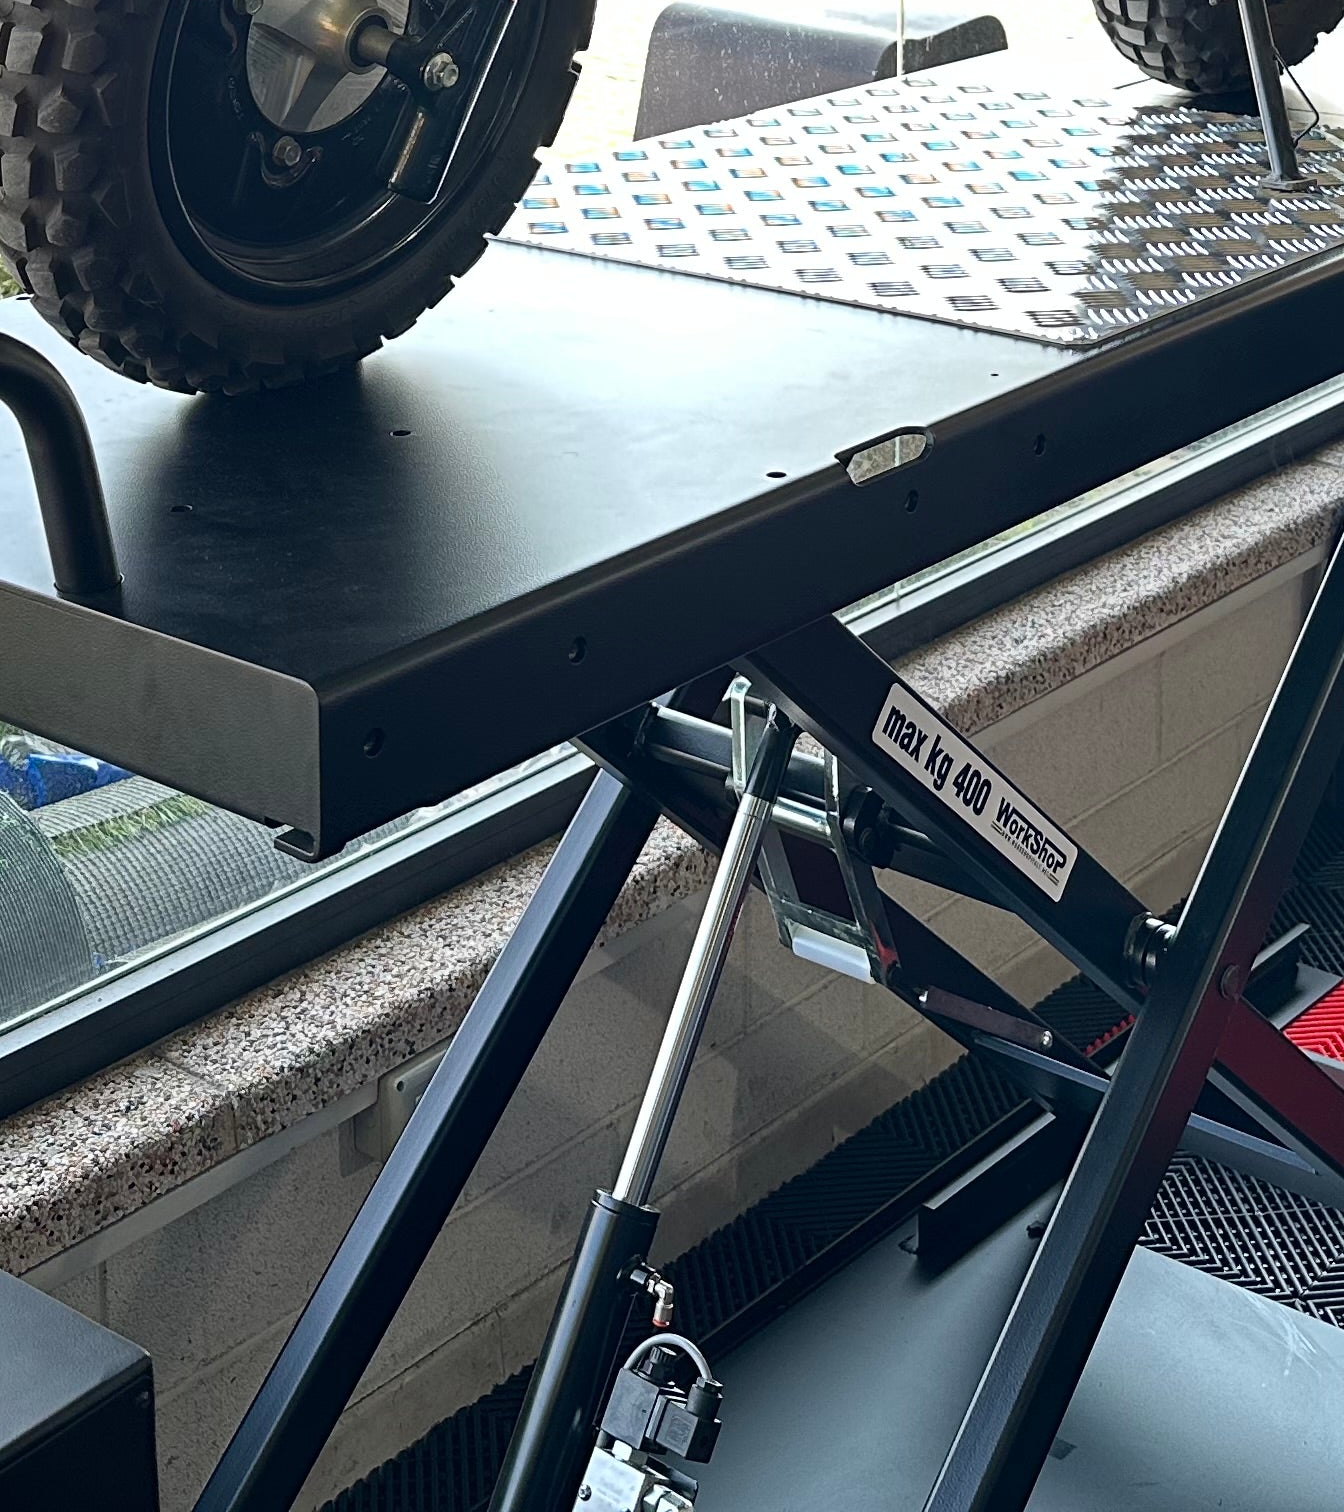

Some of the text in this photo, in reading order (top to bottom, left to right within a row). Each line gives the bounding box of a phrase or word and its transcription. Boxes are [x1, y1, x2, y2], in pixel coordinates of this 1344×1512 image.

[881, 704, 929, 764] max
[923, 734, 955, 792] kg
[952, 762, 993, 817] 400
